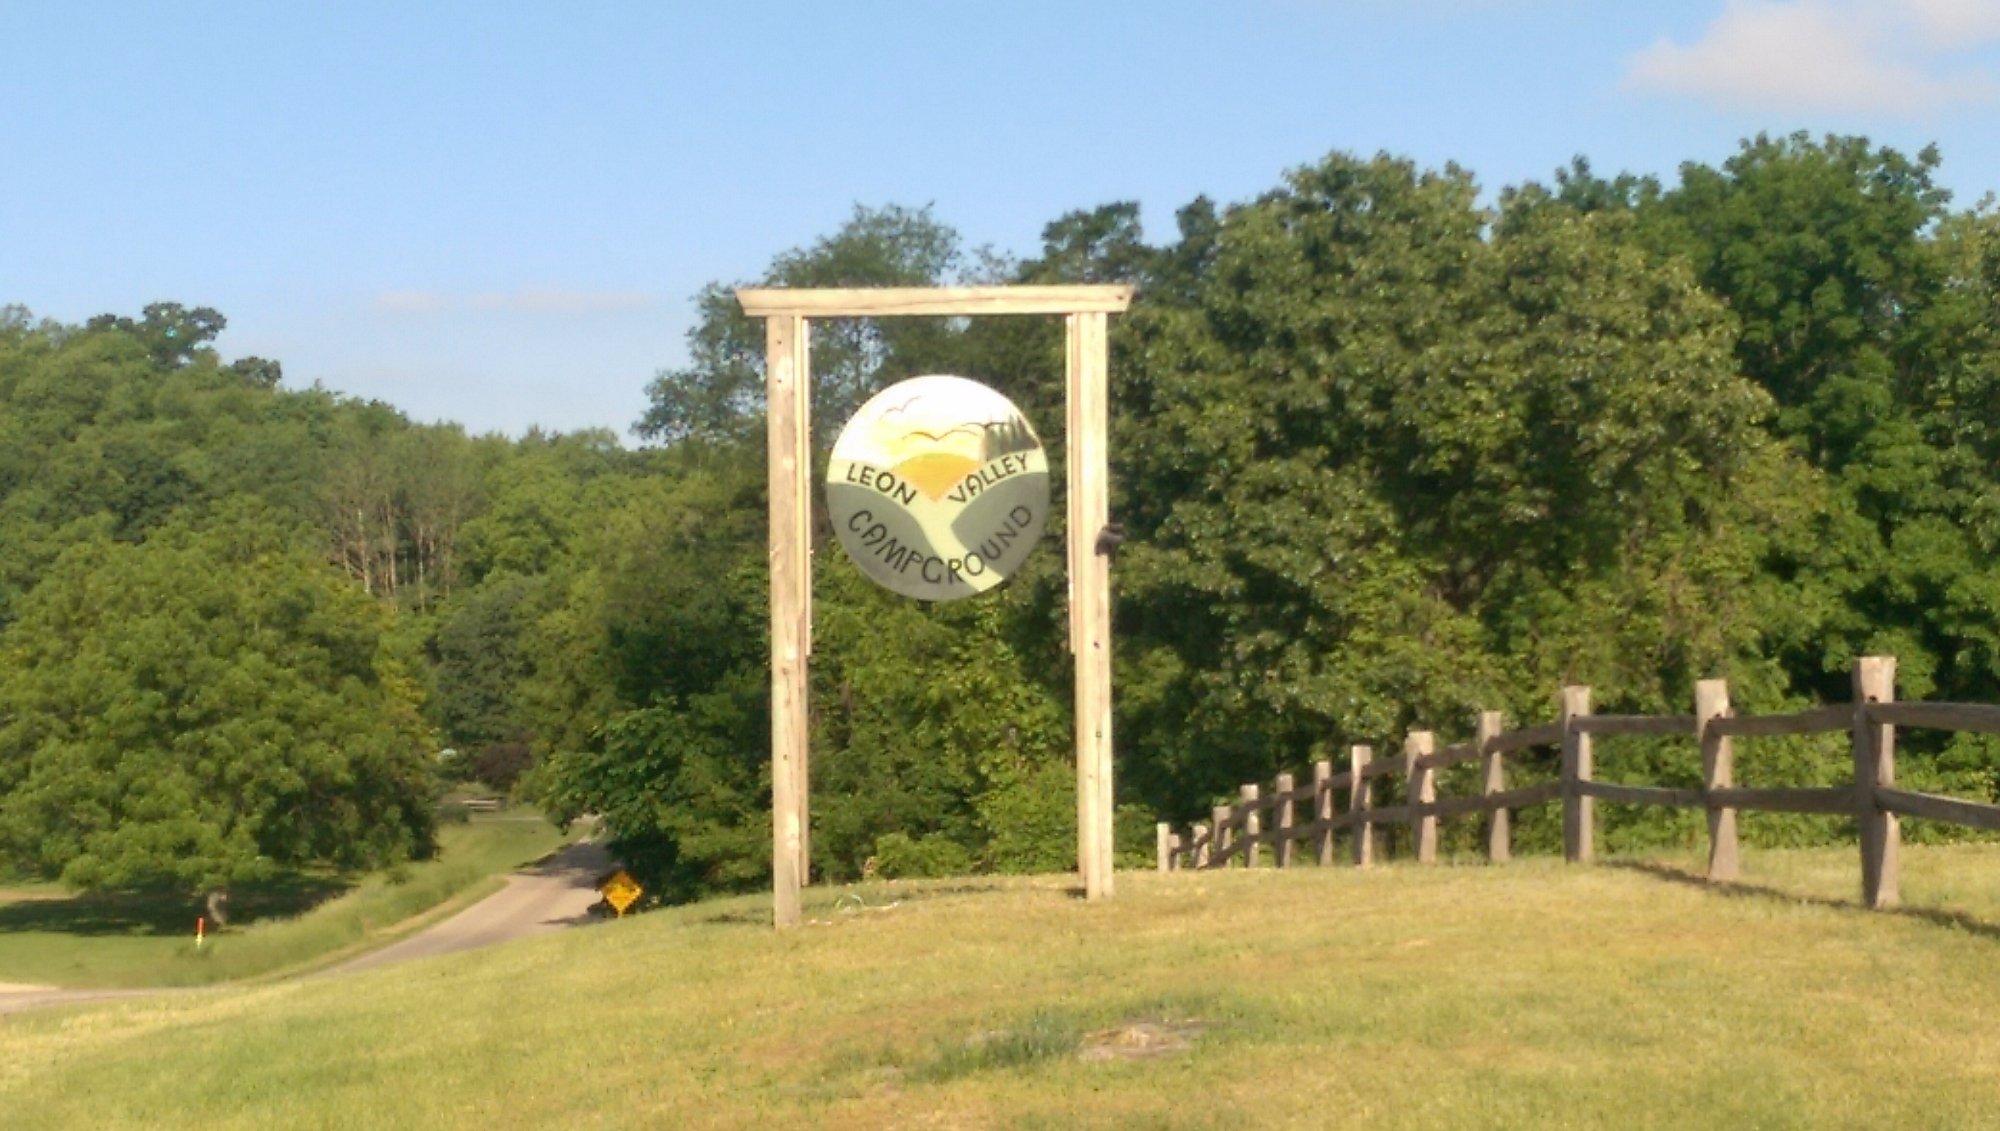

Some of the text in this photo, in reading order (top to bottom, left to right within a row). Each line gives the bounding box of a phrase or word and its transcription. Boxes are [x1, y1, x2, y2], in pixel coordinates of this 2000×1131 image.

[847, 453, 1028, 505] LEON VALLEY
[848, 505, 1032, 584] CAMPGROUND
